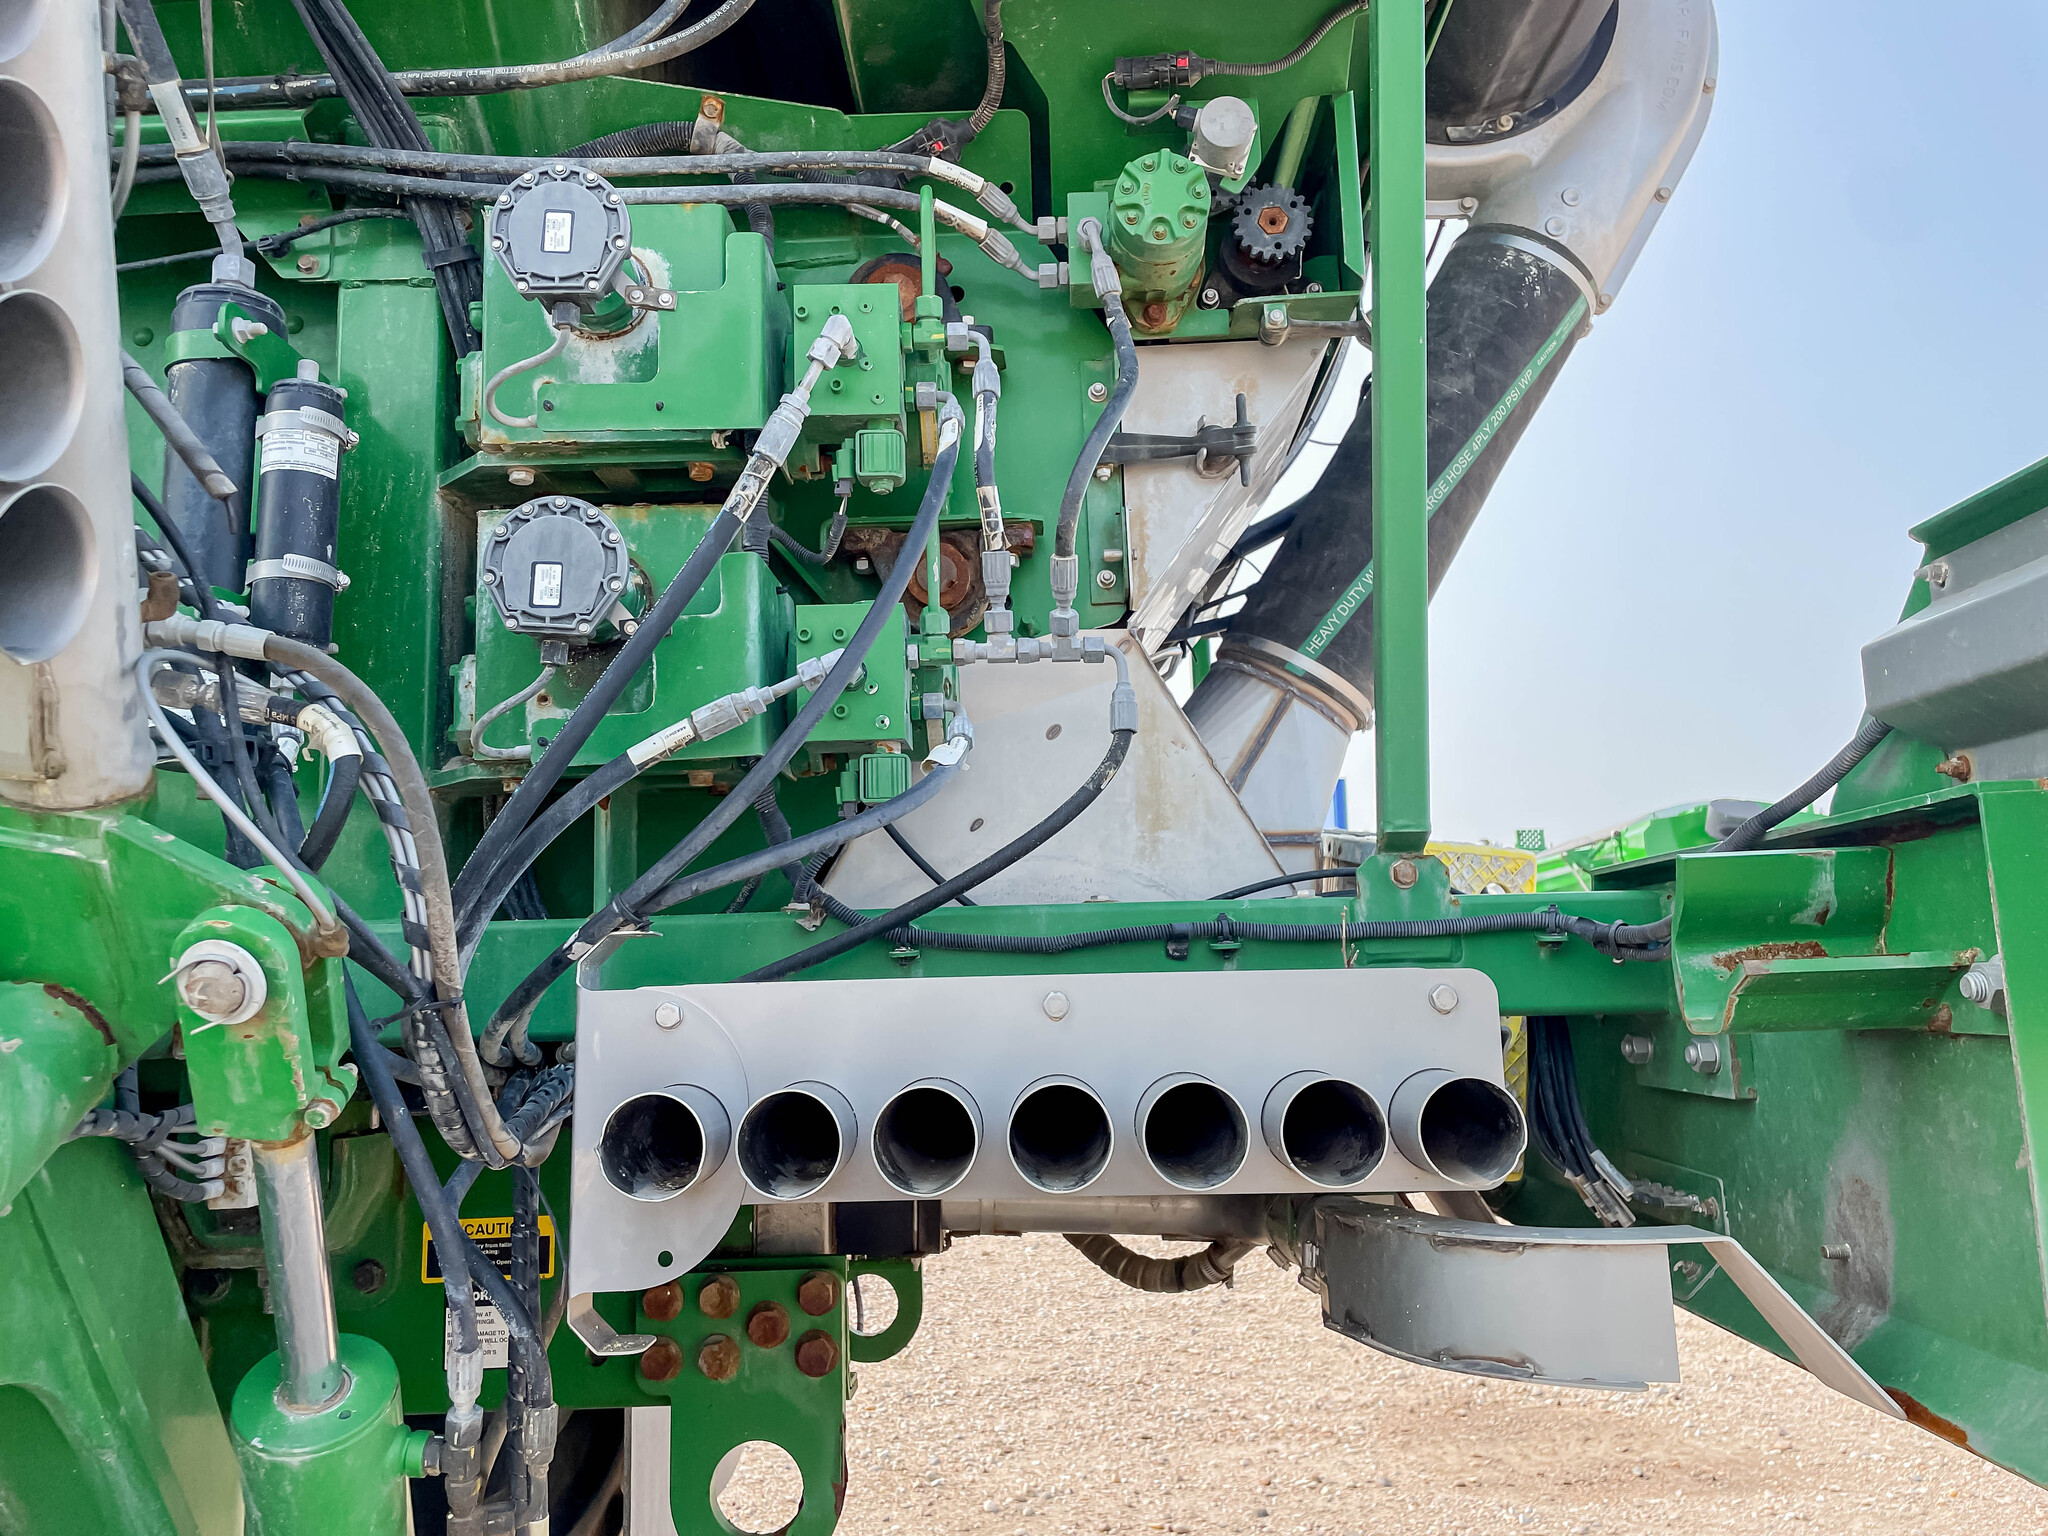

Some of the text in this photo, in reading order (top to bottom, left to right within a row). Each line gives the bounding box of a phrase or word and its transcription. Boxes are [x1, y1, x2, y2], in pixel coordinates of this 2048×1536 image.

[625, 47, 640, 59] Type
[656, 34, 677, 47] Flame
[677, 21, 706, 40] Resistant
[1446, 449, 1474, 484] HOSE
[1471, 425, 1493, 452] 4PLY
[1490, 404, 1507, 427] 200
[1505, 386, 1521, 409] PSI
[1519, 368, 1534, 391] WP
[1305, 613, 1340, 654] HEAVY
[1337, 582, 1366, 616] DUTY
